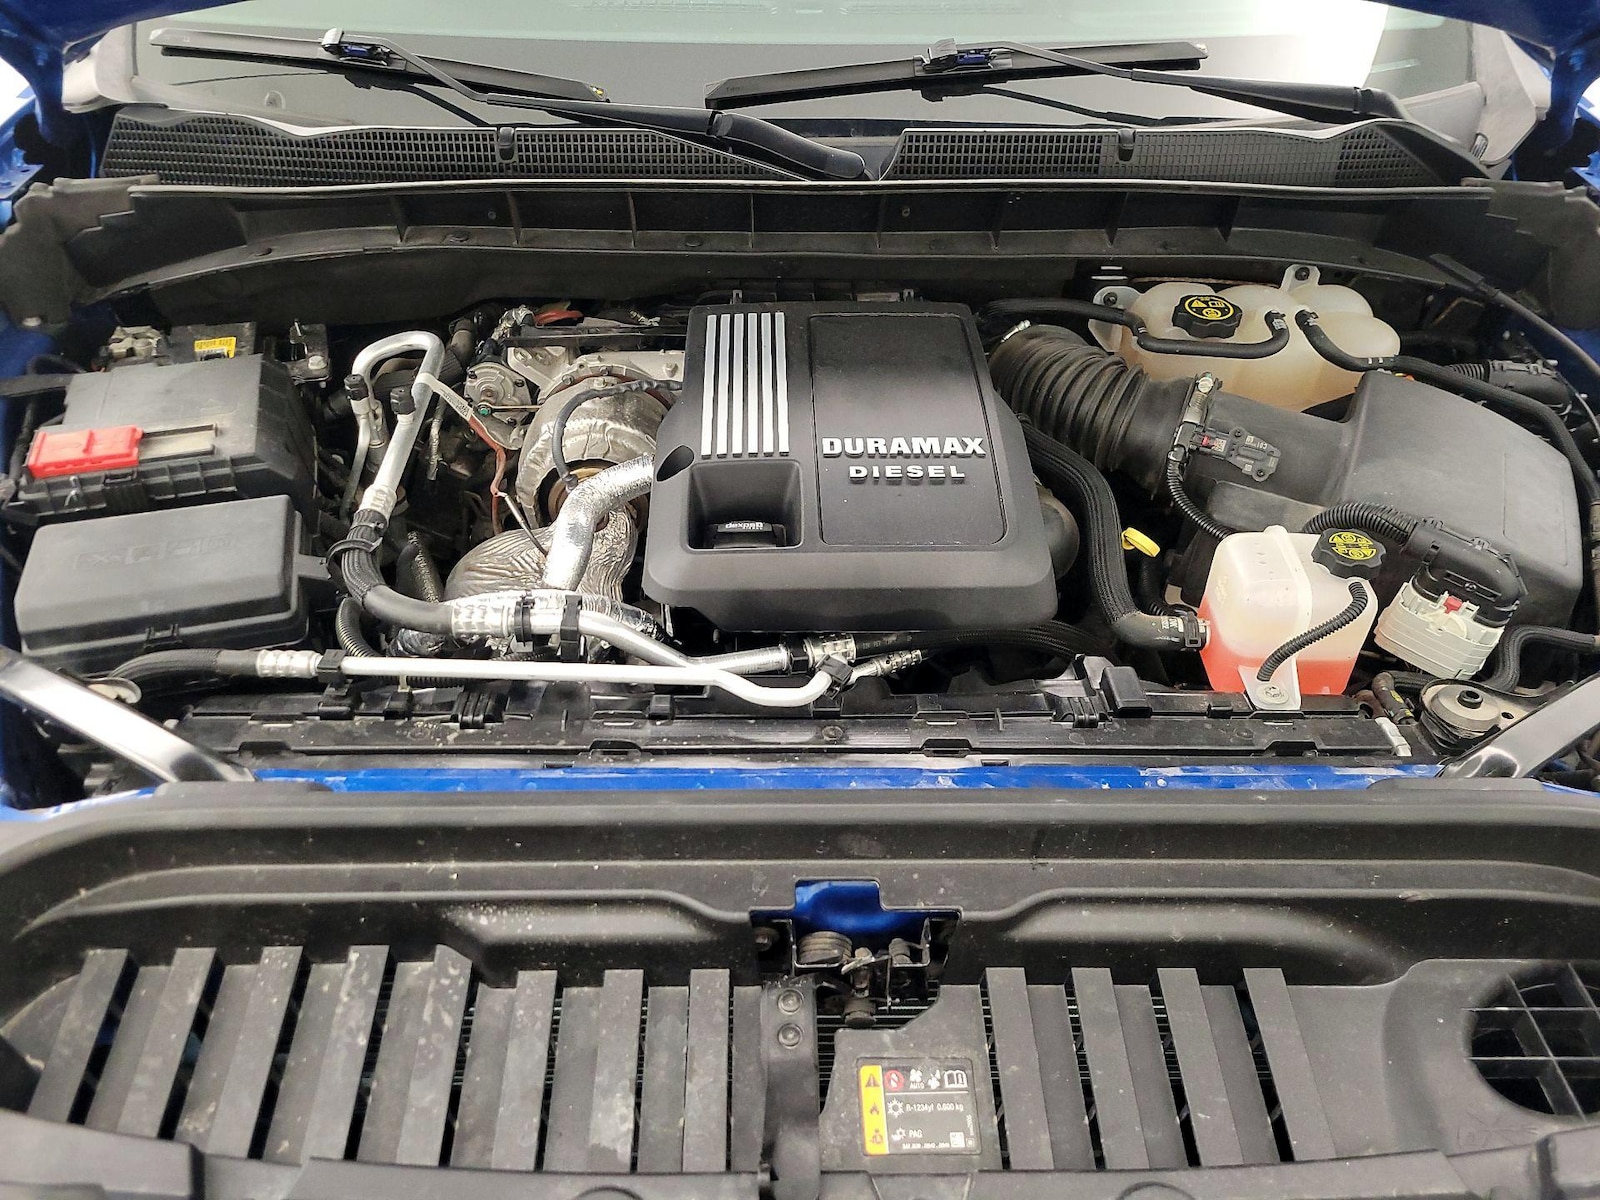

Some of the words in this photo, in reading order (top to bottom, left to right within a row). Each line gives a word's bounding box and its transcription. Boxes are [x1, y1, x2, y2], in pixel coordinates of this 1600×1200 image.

[821, 436, 987, 456] DURAMAX
[849, 465, 966, 479] DIESEL
[955, 1102, 964, 1112] kg
[909, 1129, 923, 1138] PAG
